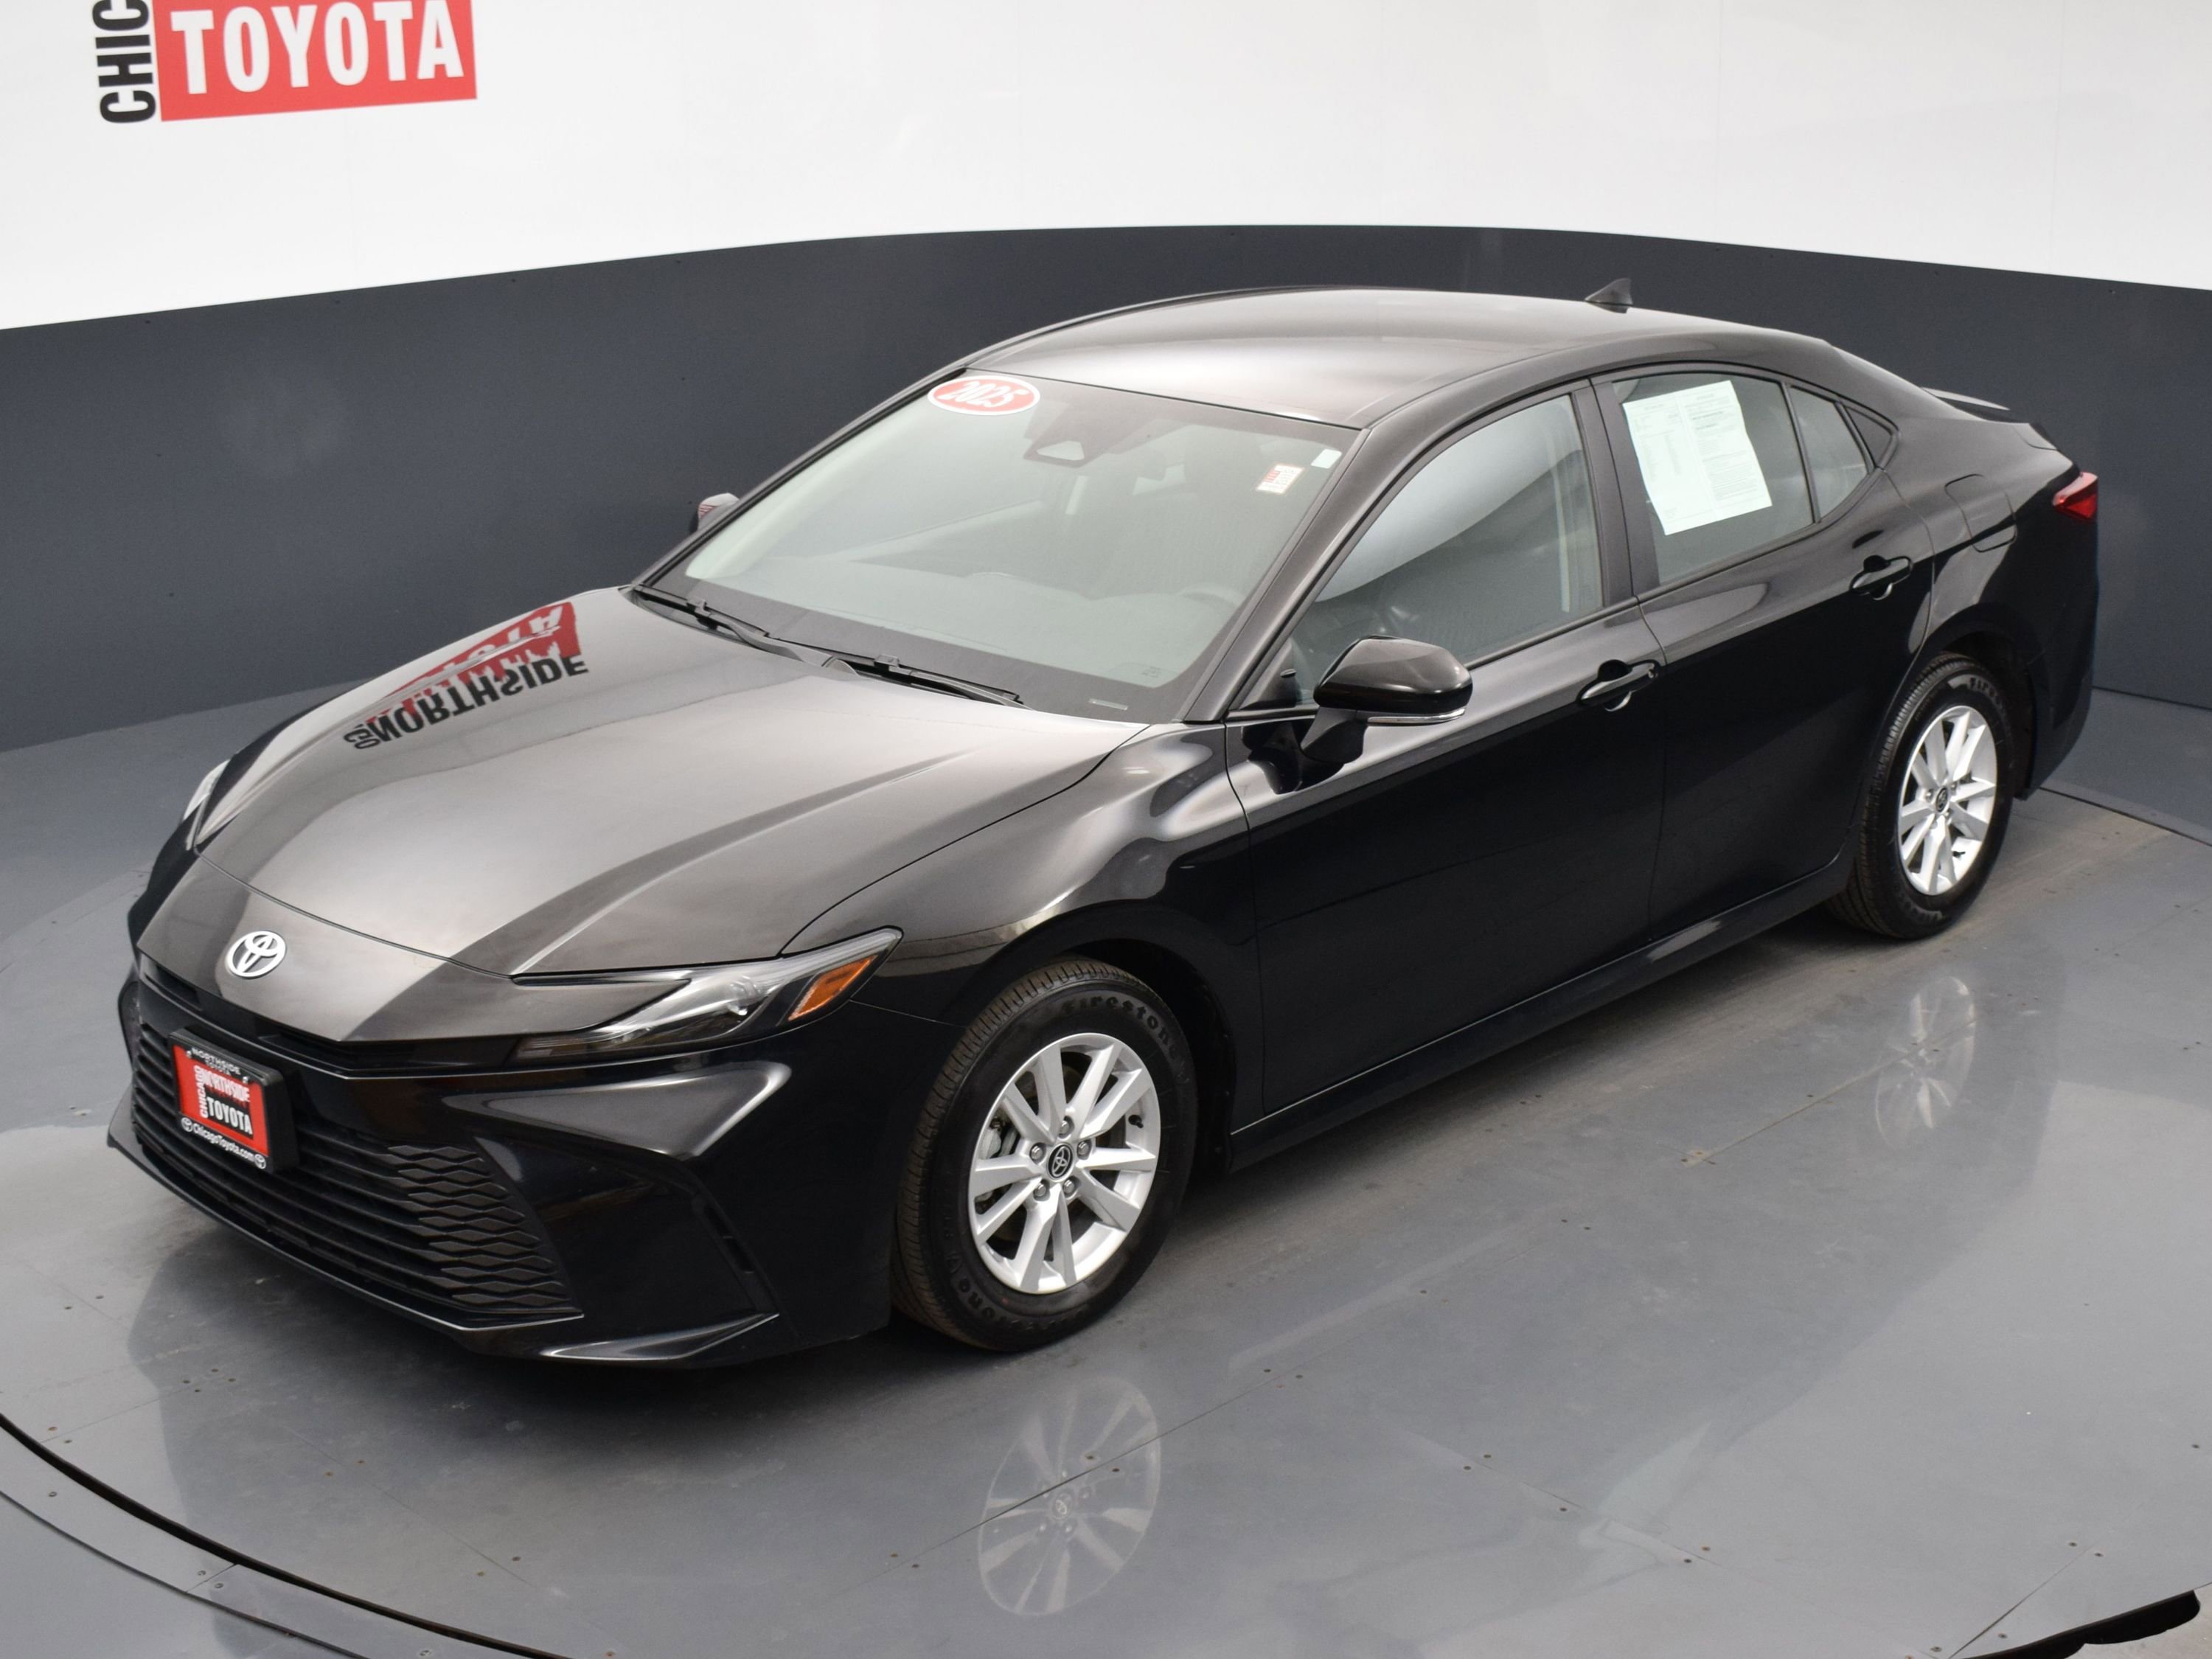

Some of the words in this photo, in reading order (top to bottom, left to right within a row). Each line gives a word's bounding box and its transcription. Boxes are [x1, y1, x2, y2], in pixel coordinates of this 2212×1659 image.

[170, 0, 465, 95] TOYOTA
[936, 380, 1030, 408] 2025
[207, 1096, 253, 1135] TOYOTA
